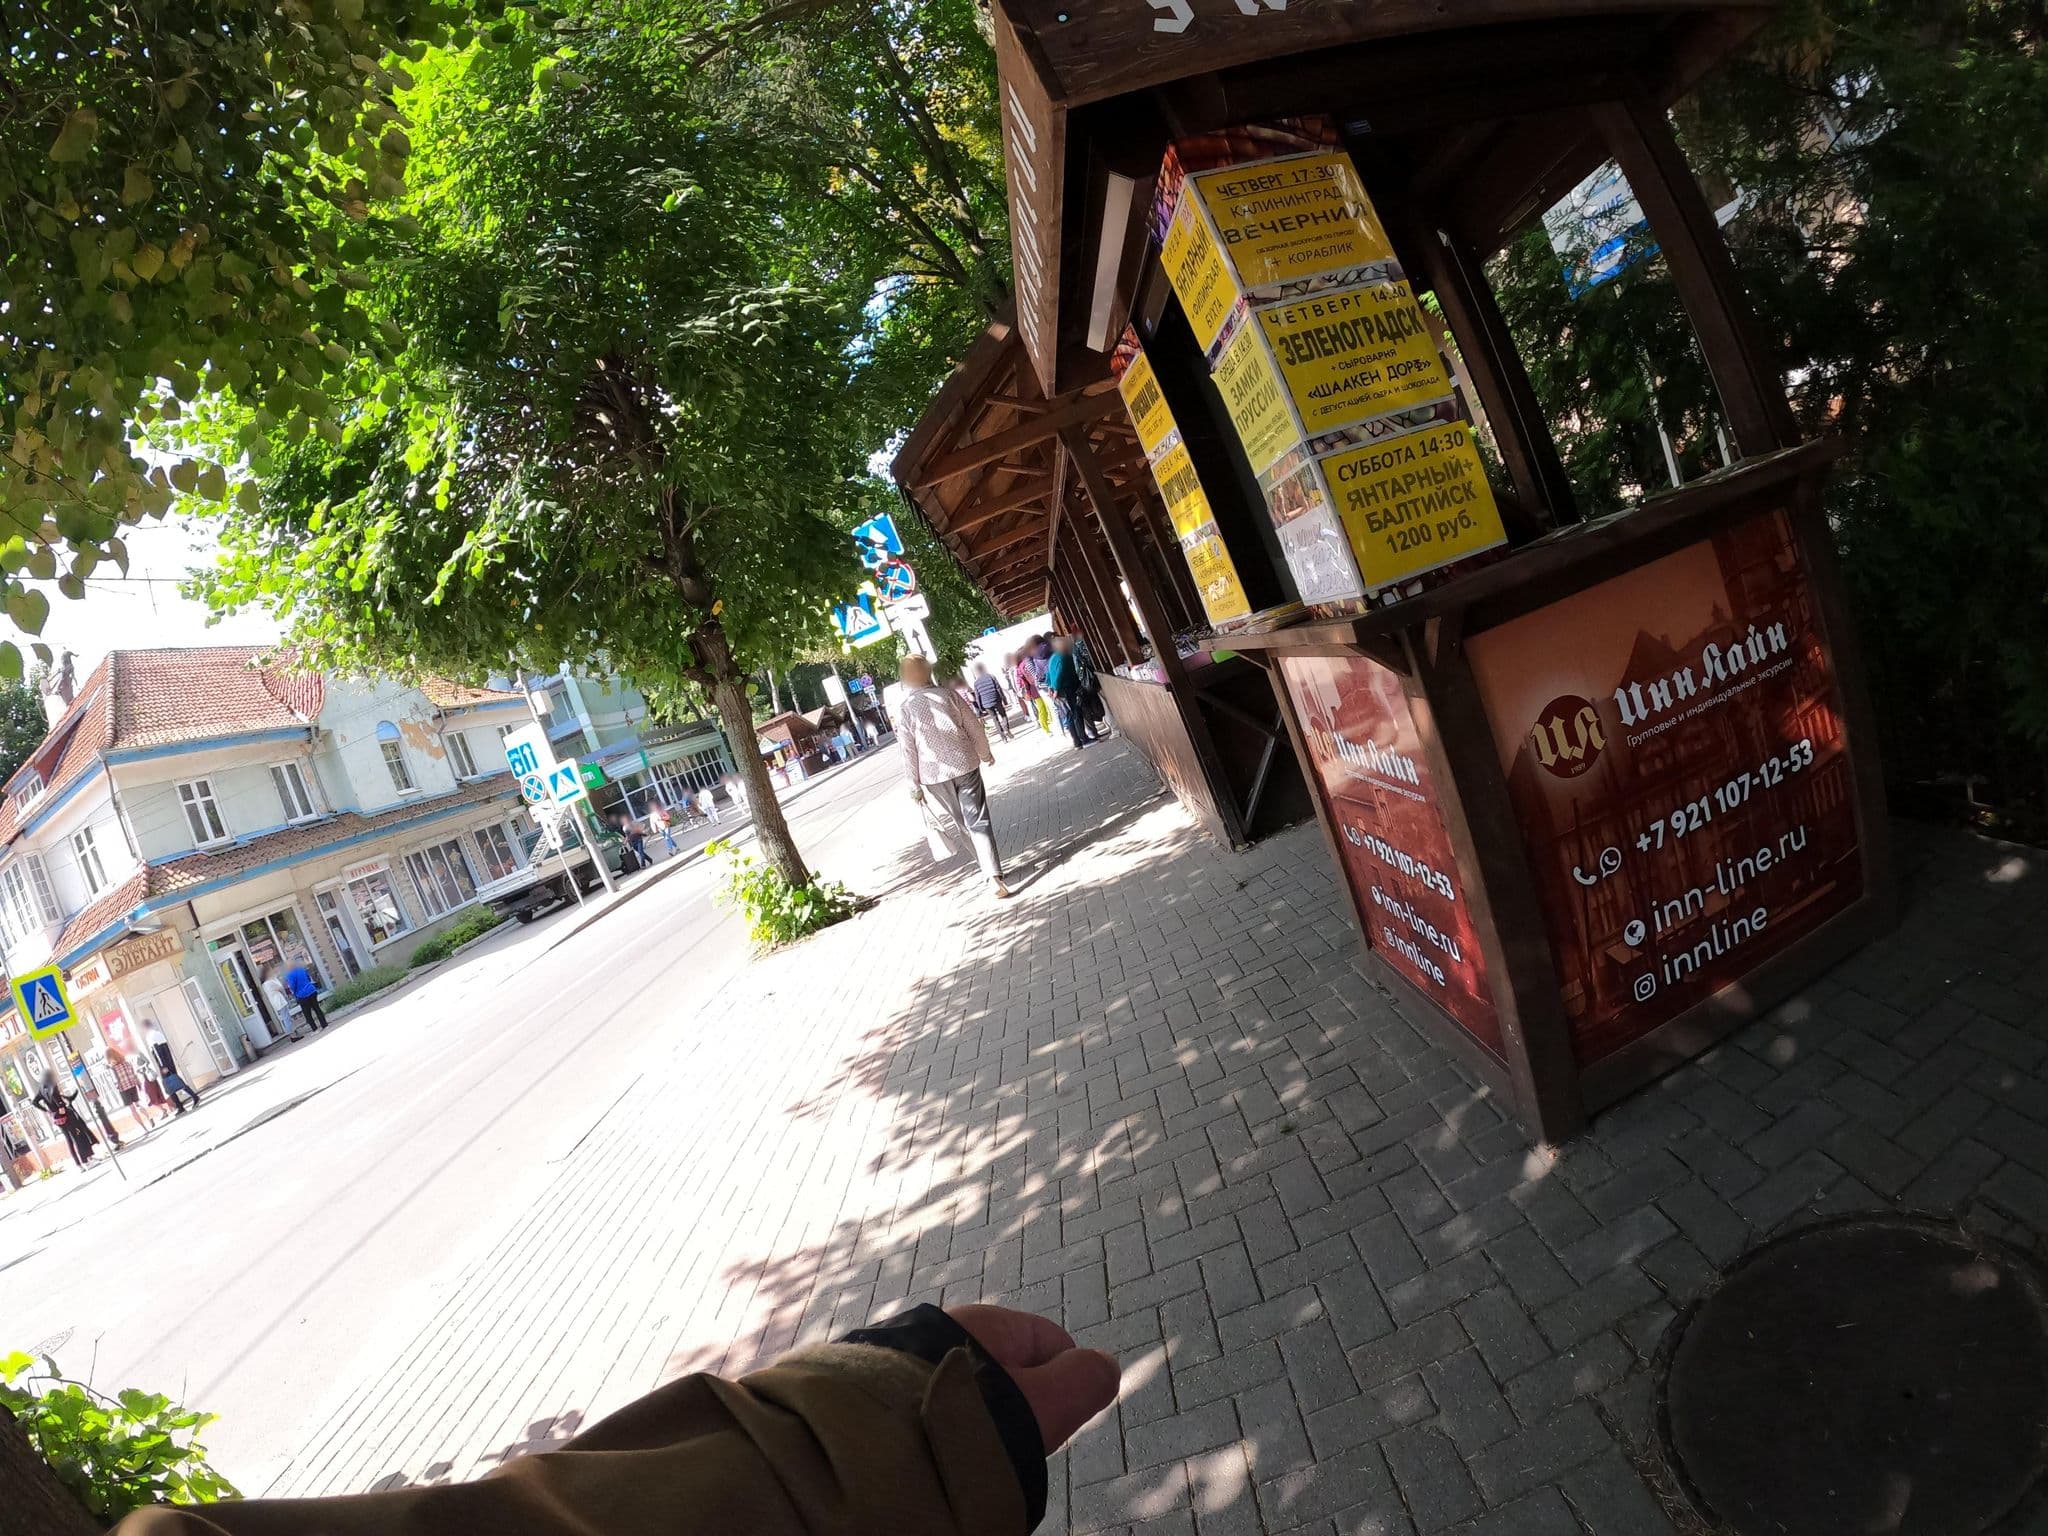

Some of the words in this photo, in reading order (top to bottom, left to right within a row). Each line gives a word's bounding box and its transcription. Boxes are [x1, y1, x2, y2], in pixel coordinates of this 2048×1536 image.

[1217, 173, 1284, 197] ЧЕТВЕРГ
[1292, 165, 1335, 184] 17:30
[1230, 186, 1343, 219] КАЛИНИНГРАД
[1223, 202, 1368, 245] ВЕЧЕРНИЙ
[1175, 220, 1212, 301] ЯНТАРНЫЙ
[1288, 242, 1354, 265] КОРАБЛИК
[1205, 298, 1224, 329] БУХТА
[1268, 294, 1362, 327] ЧЕТВЕРГ
[1278, 304, 1425, 366] ЗЕЛЕНОГРАДСК
[1230, 356, 1263, 406] ЗАМКИ
[1307, 369, 1382, 400] «ШААКЕН
[1338, 348, 1398, 371] СЫРОВАРНЯ
[1235, 379, 1279, 433] ПРУССИИ
[1320, 392, 1373, 416] ДЕГУСТАЦИЕЙ
[1337, 447, 1416, 482] СУББОТА
[1419, 430, 1465, 458] 14:30
[1365, 480, 1478, 533] БАЛТИЙСК
[1386, 522, 1432, 554] 1200
[1436, 508, 1478, 542] руб.
[1626, 716, 1677, 748] Групповые
[1678, 712, 1686, 722] и
[1686, 677, 1757, 718] индивидуальные
[1636, 819, 1665, 852] +7
[1670, 795, 1713, 838] 921
[1714, 738, 1814, 813] 107-12-53
[1364, 834, 1377, 856] +7
[1375, 839, 1396, 868] 921
[1395, 849, 1455, 901] 107-12-53
[1652, 825, 1807, 933] inn-line.ru
[1379, 885, 1462, 963] inn-line.ru
[1661, 905, 1768, 985] innline
[111, 936, 174, 974] ЭЛЕГАНТ
[1391, 927, 1446, 987] innline
